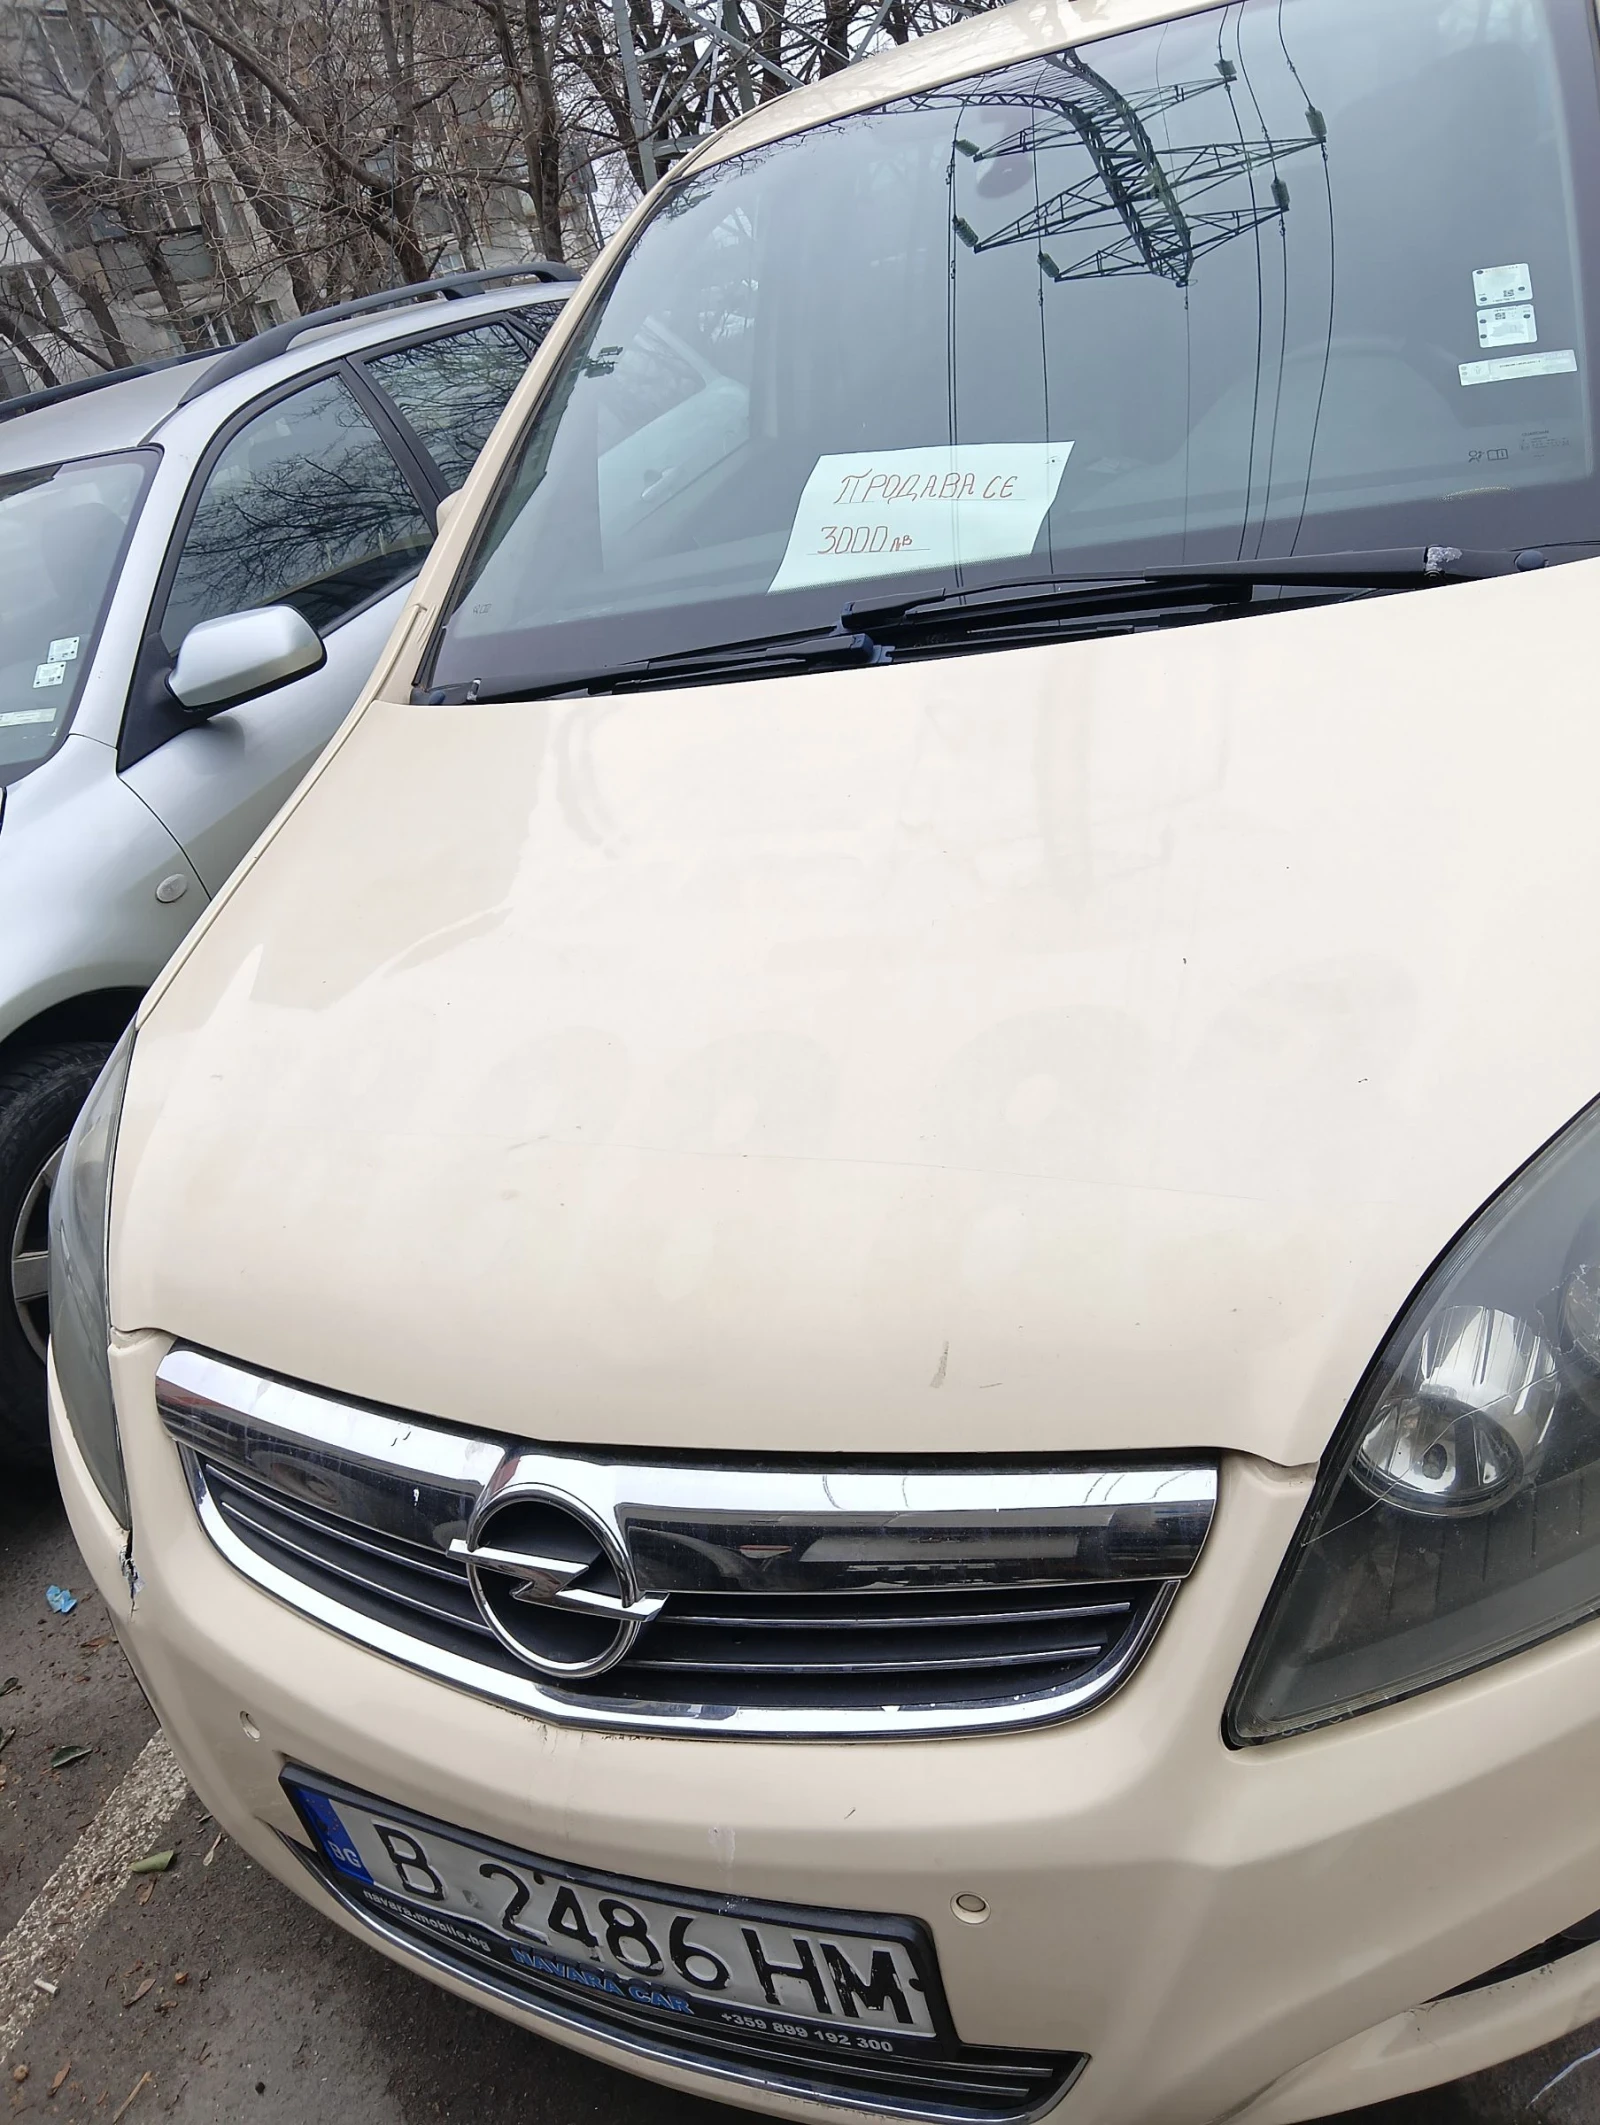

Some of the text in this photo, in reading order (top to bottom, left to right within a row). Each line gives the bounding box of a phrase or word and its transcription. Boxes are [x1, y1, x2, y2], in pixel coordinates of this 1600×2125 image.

[834, 469, 974, 504] ПРОДАВА
[328, 1840, 362, 1868] BG
[363, 1889, 491, 1952] navara.mobile.bg
[479, 1863, 730, 1989] 2486
[510, 1946, 695, 2015] NAVARA CAR
[721, 2012, 893, 2052] +359 899 192 300
